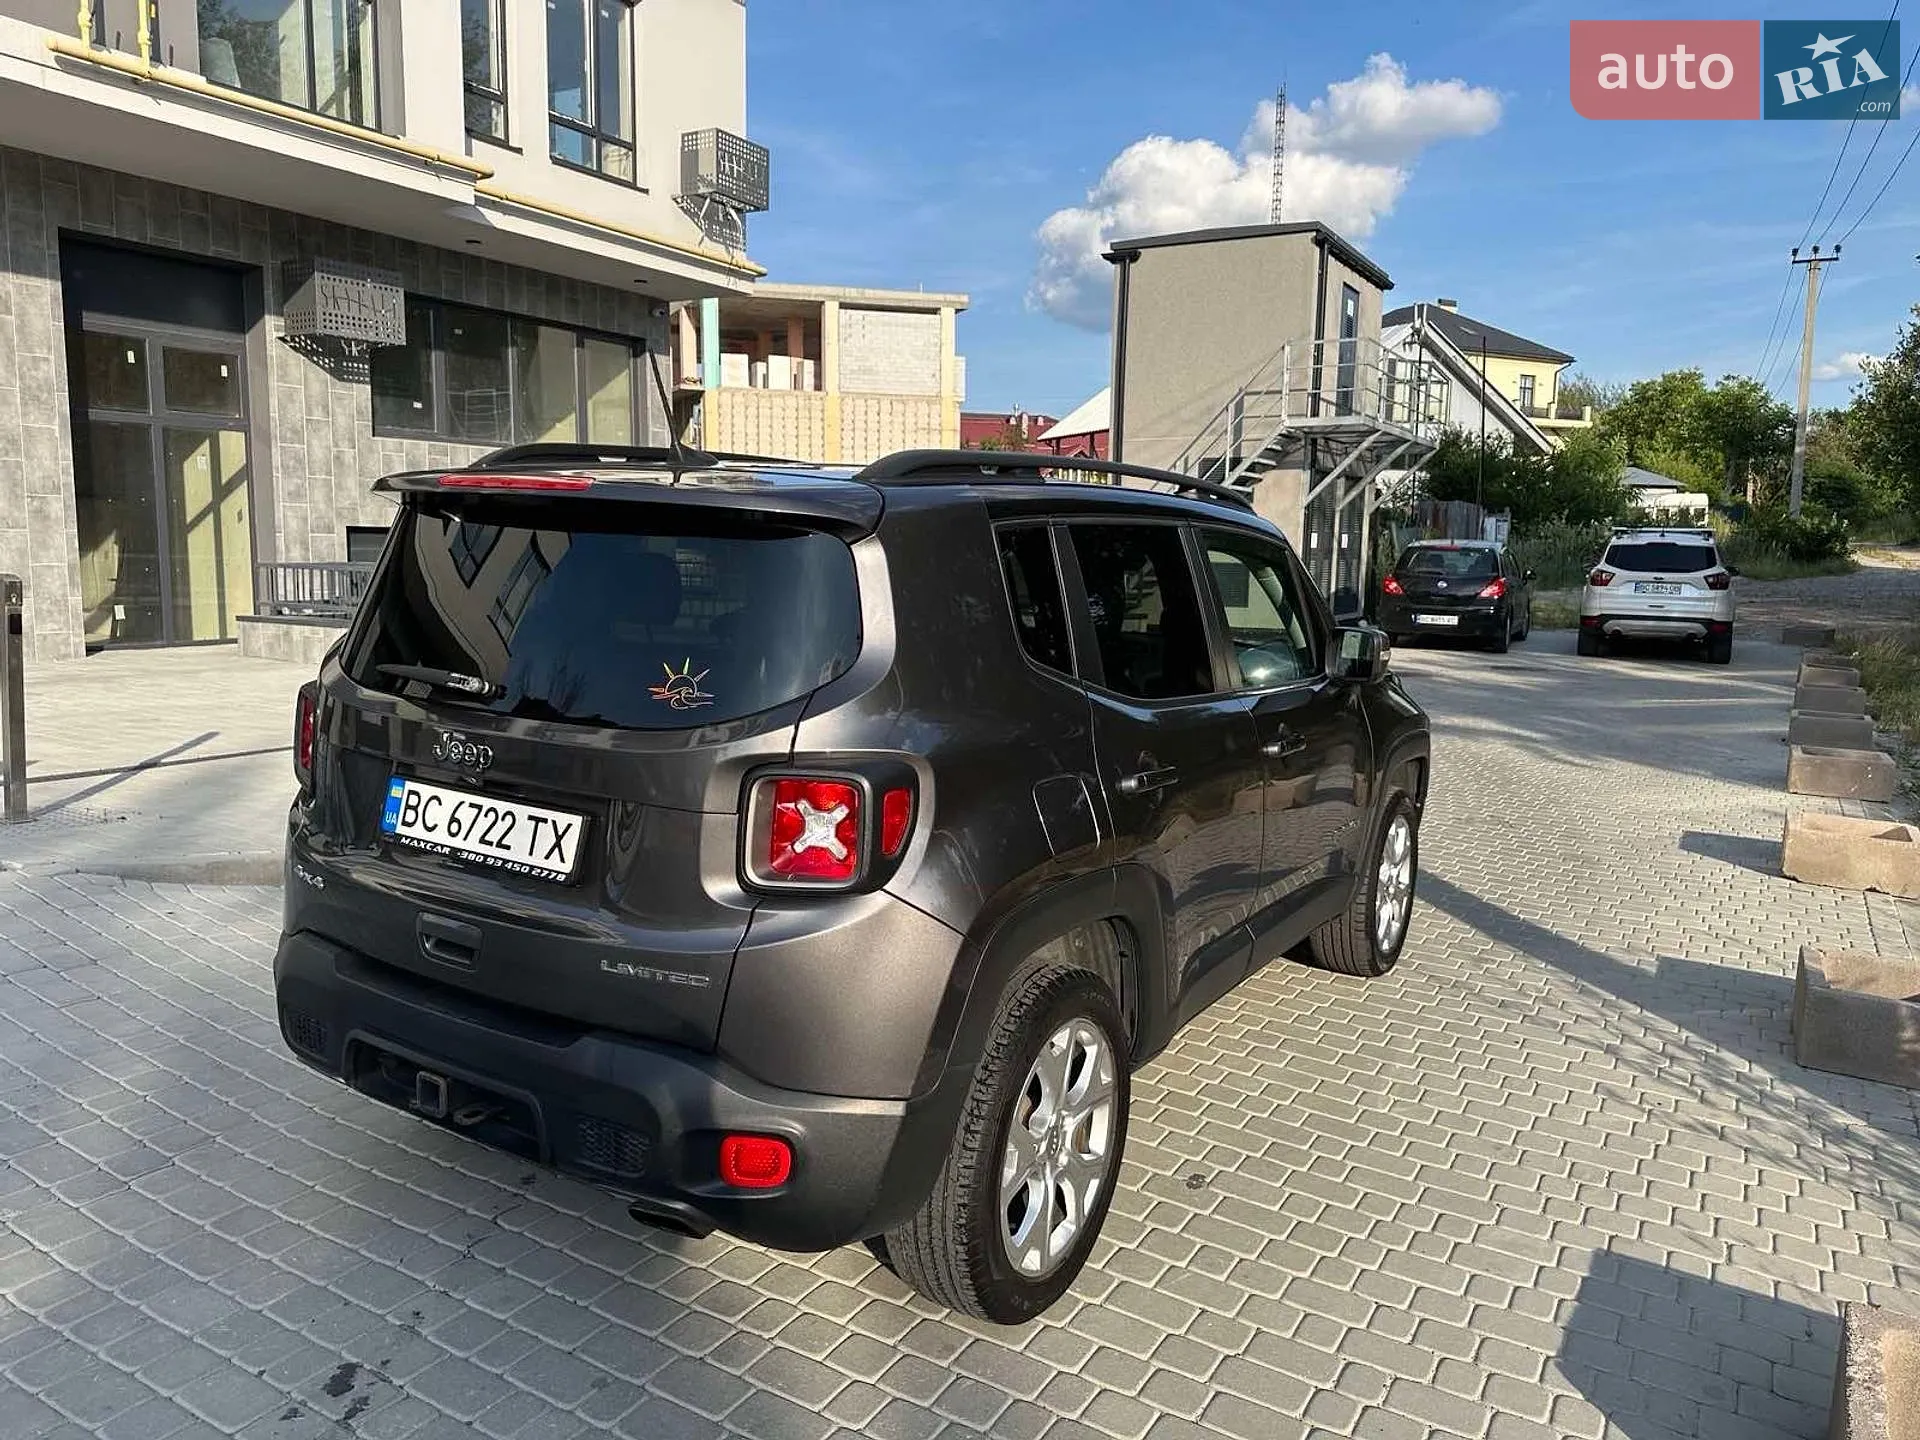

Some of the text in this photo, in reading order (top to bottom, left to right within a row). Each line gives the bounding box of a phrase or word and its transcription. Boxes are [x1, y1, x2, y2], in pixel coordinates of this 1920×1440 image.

[432, 731, 494, 773] Jeep
[385, 811, 397, 825] UA
[401, 789, 573, 864] BC 6722 TX
[400, 836, 451, 856] MAXCAR
[486, 856, 502, 868] 93
[504, 860, 530, 875] 450
